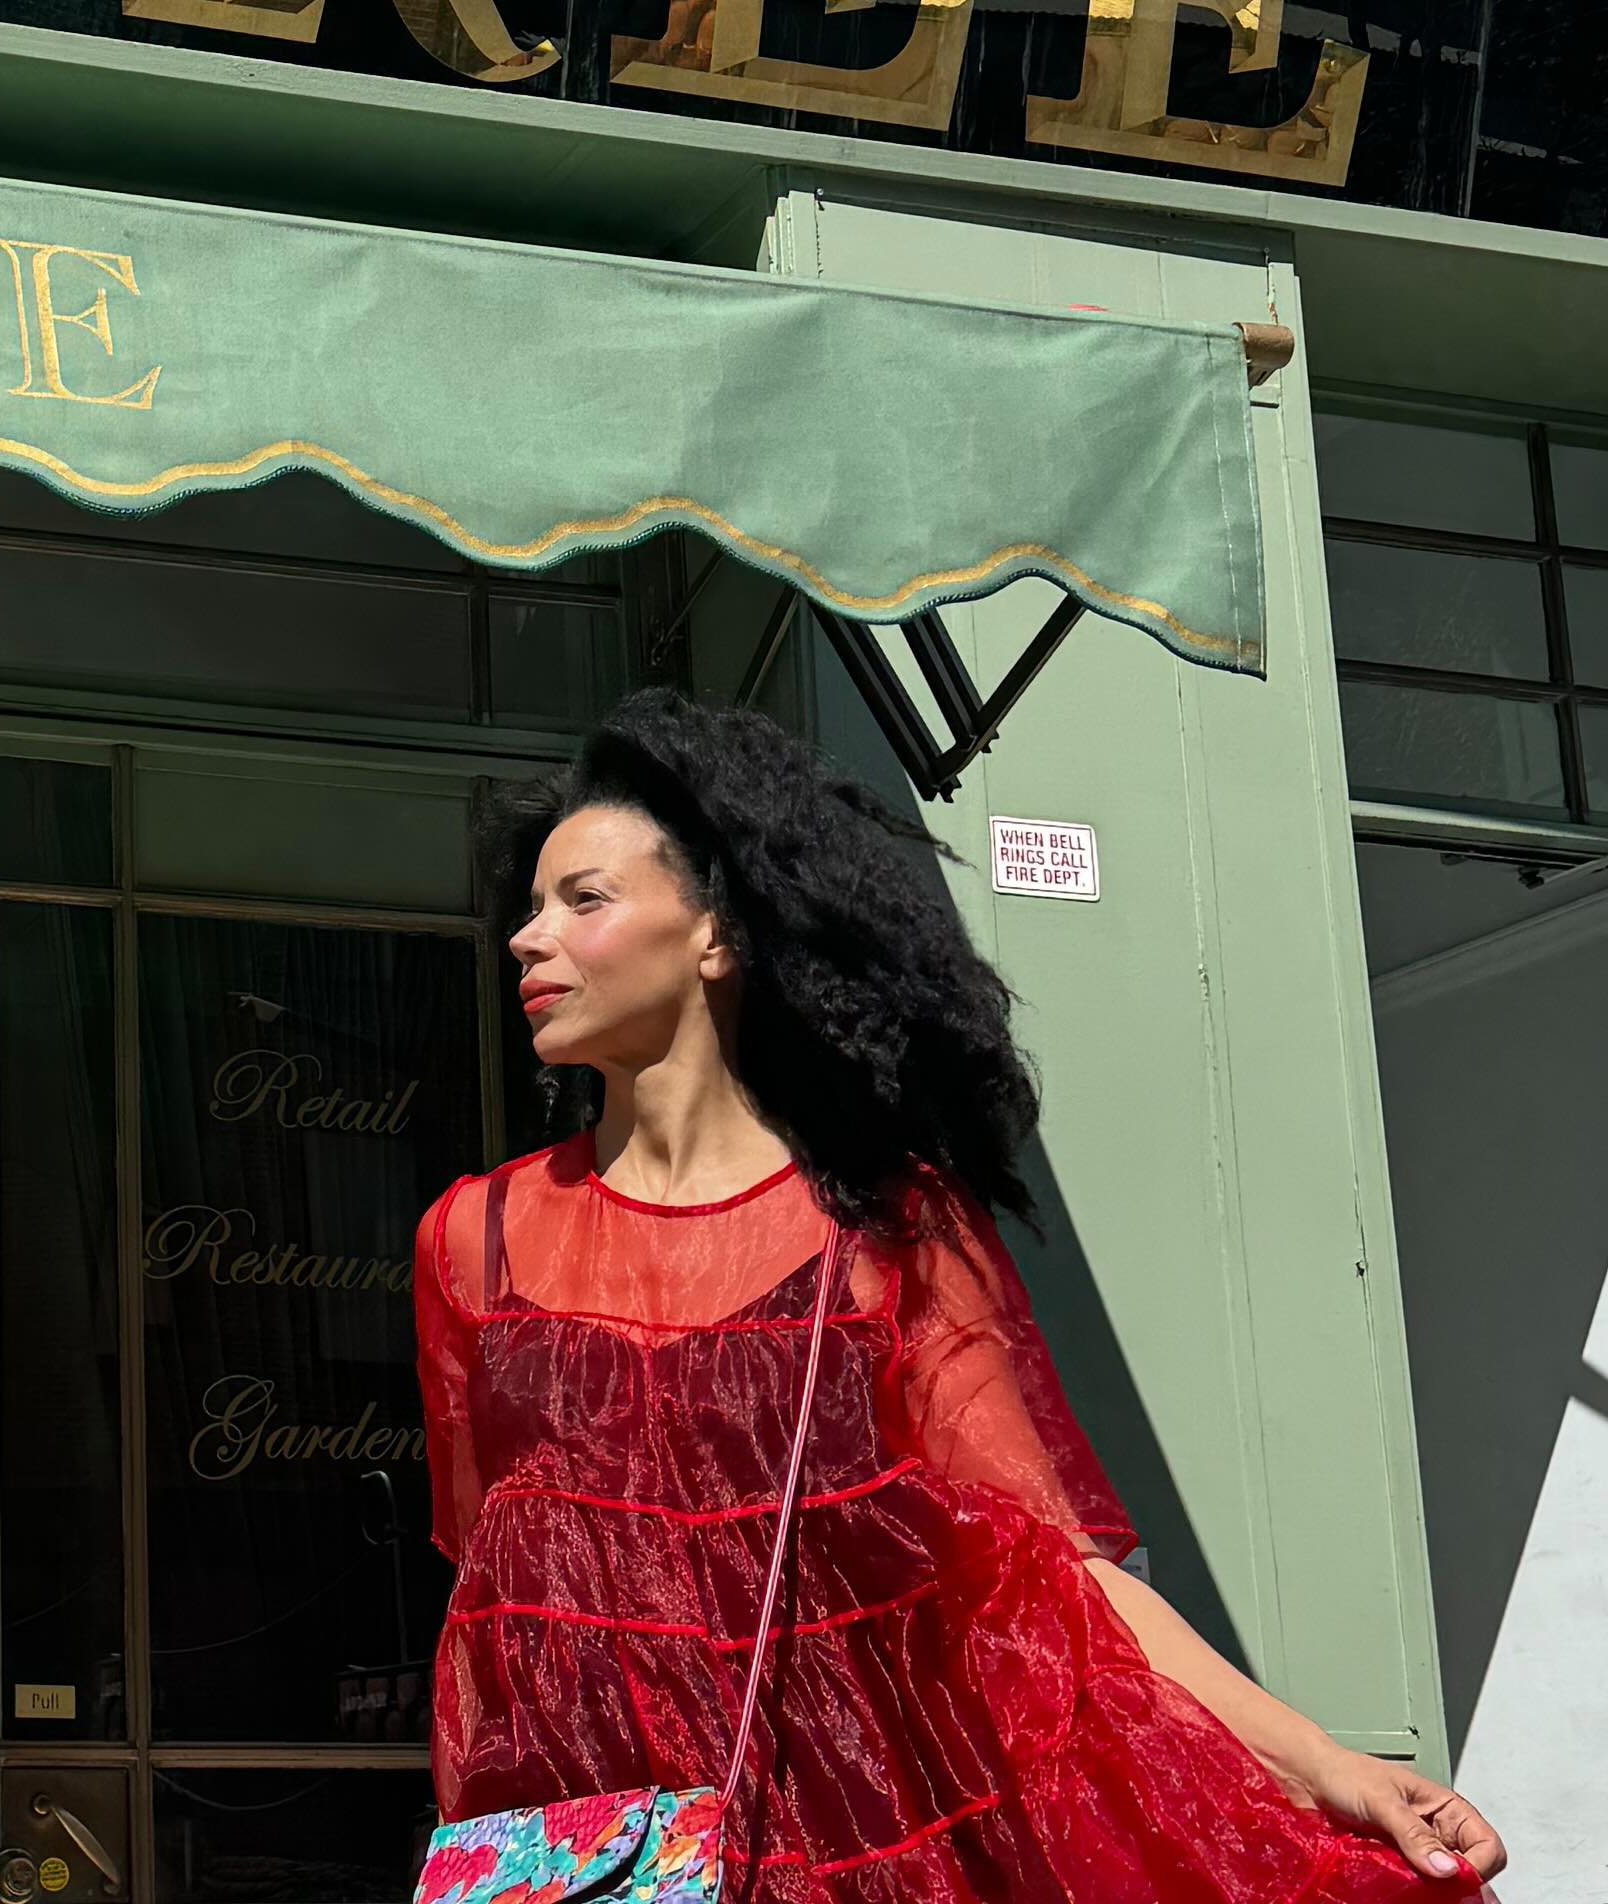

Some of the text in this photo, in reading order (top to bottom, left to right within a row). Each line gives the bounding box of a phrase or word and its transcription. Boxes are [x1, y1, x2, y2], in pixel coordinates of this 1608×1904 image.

[1000, 829, 1086, 851] WHEN BELL
[1000, 847, 1088, 869] RINGS CALL
[1006, 866, 1086, 887] FIRE DEPT.
[208, 1048, 421, 1136] Retail
[142, 1204, 415, 1293] Restaura
[188, 1373, 428, 1481] Garden
[32, 1692, 59, 1710] Pull
